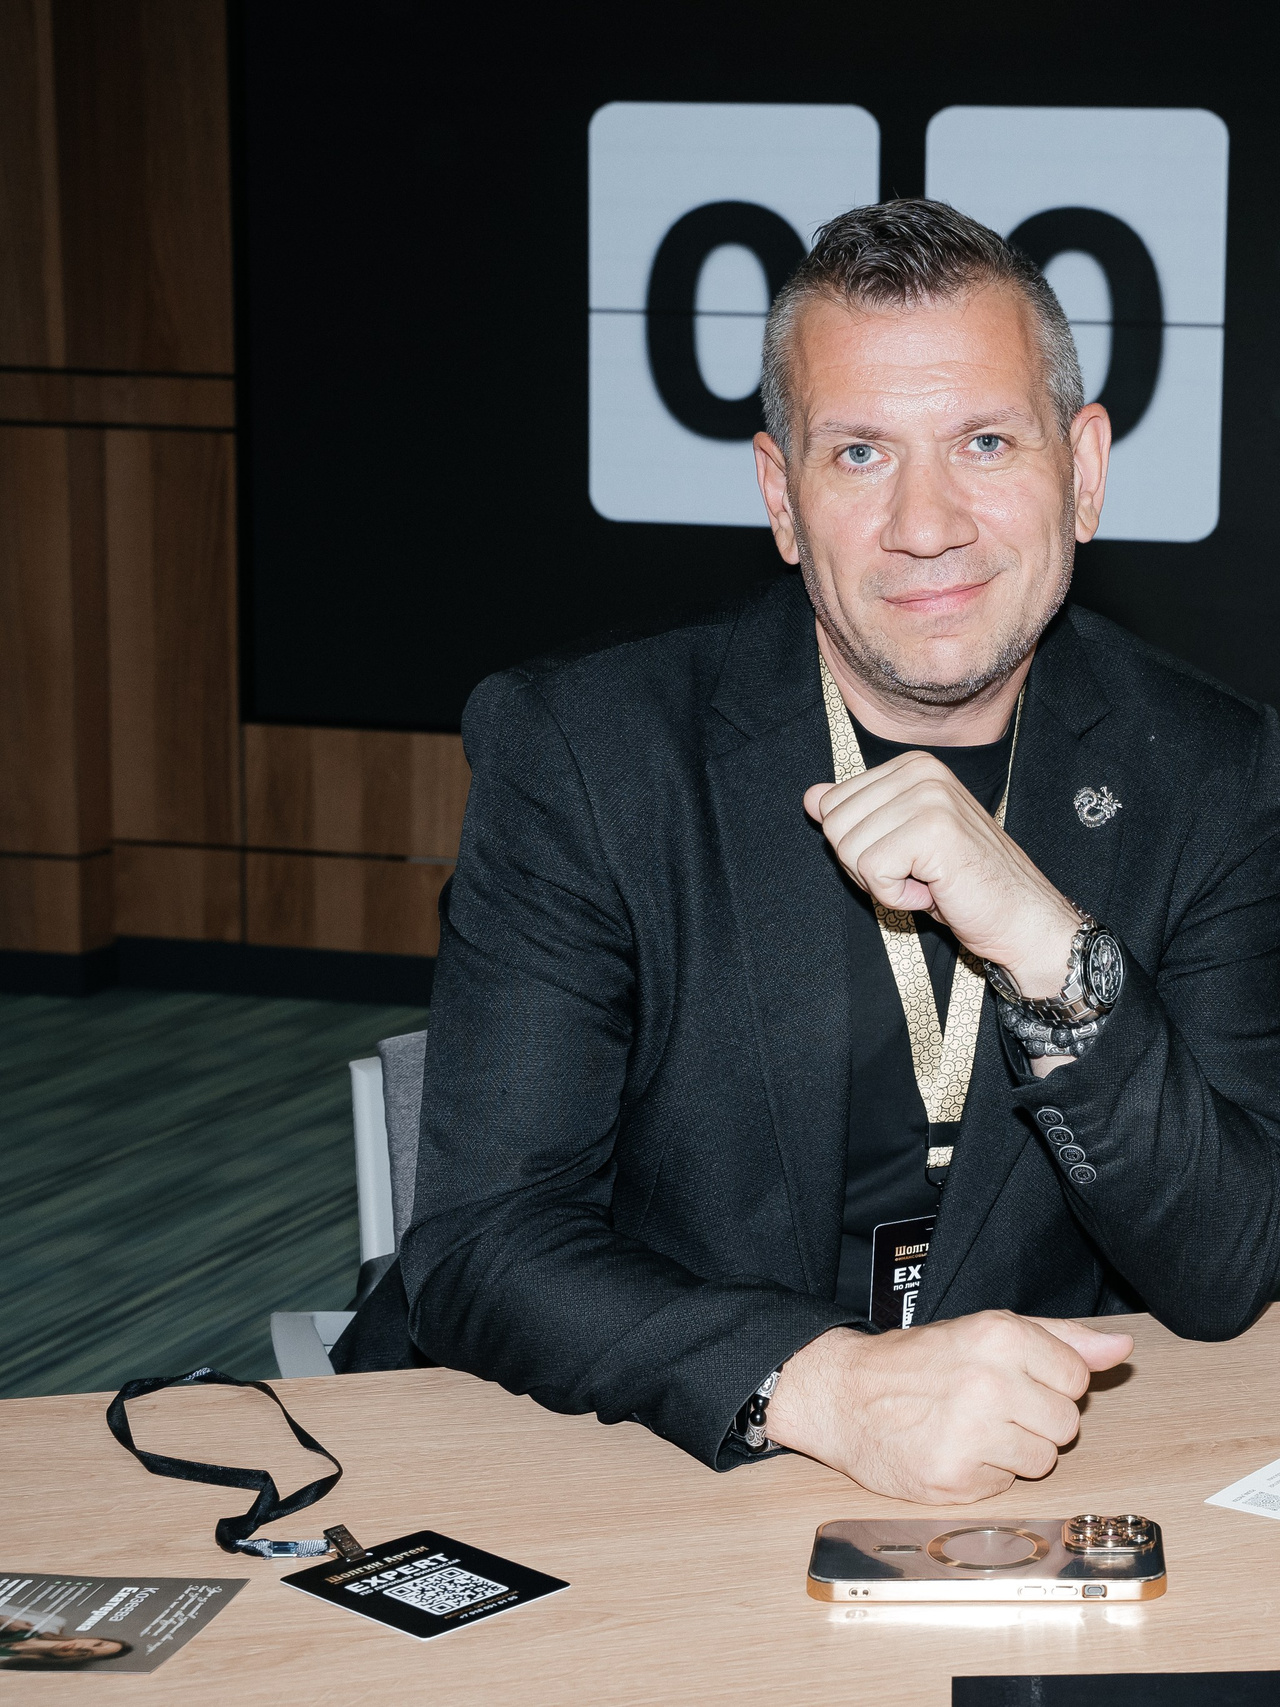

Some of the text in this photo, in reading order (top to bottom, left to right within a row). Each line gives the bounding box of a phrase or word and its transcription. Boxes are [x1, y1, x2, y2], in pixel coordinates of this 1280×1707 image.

[894, 1264, 925, 1283] EX
[325, 1561, 383, 1583] Шолгин
[383, 1546, 429, 1562] Артем
[344, 1553, 448, 1593] EXPERT
[75, 1587, 140, 1631] Екатерина
